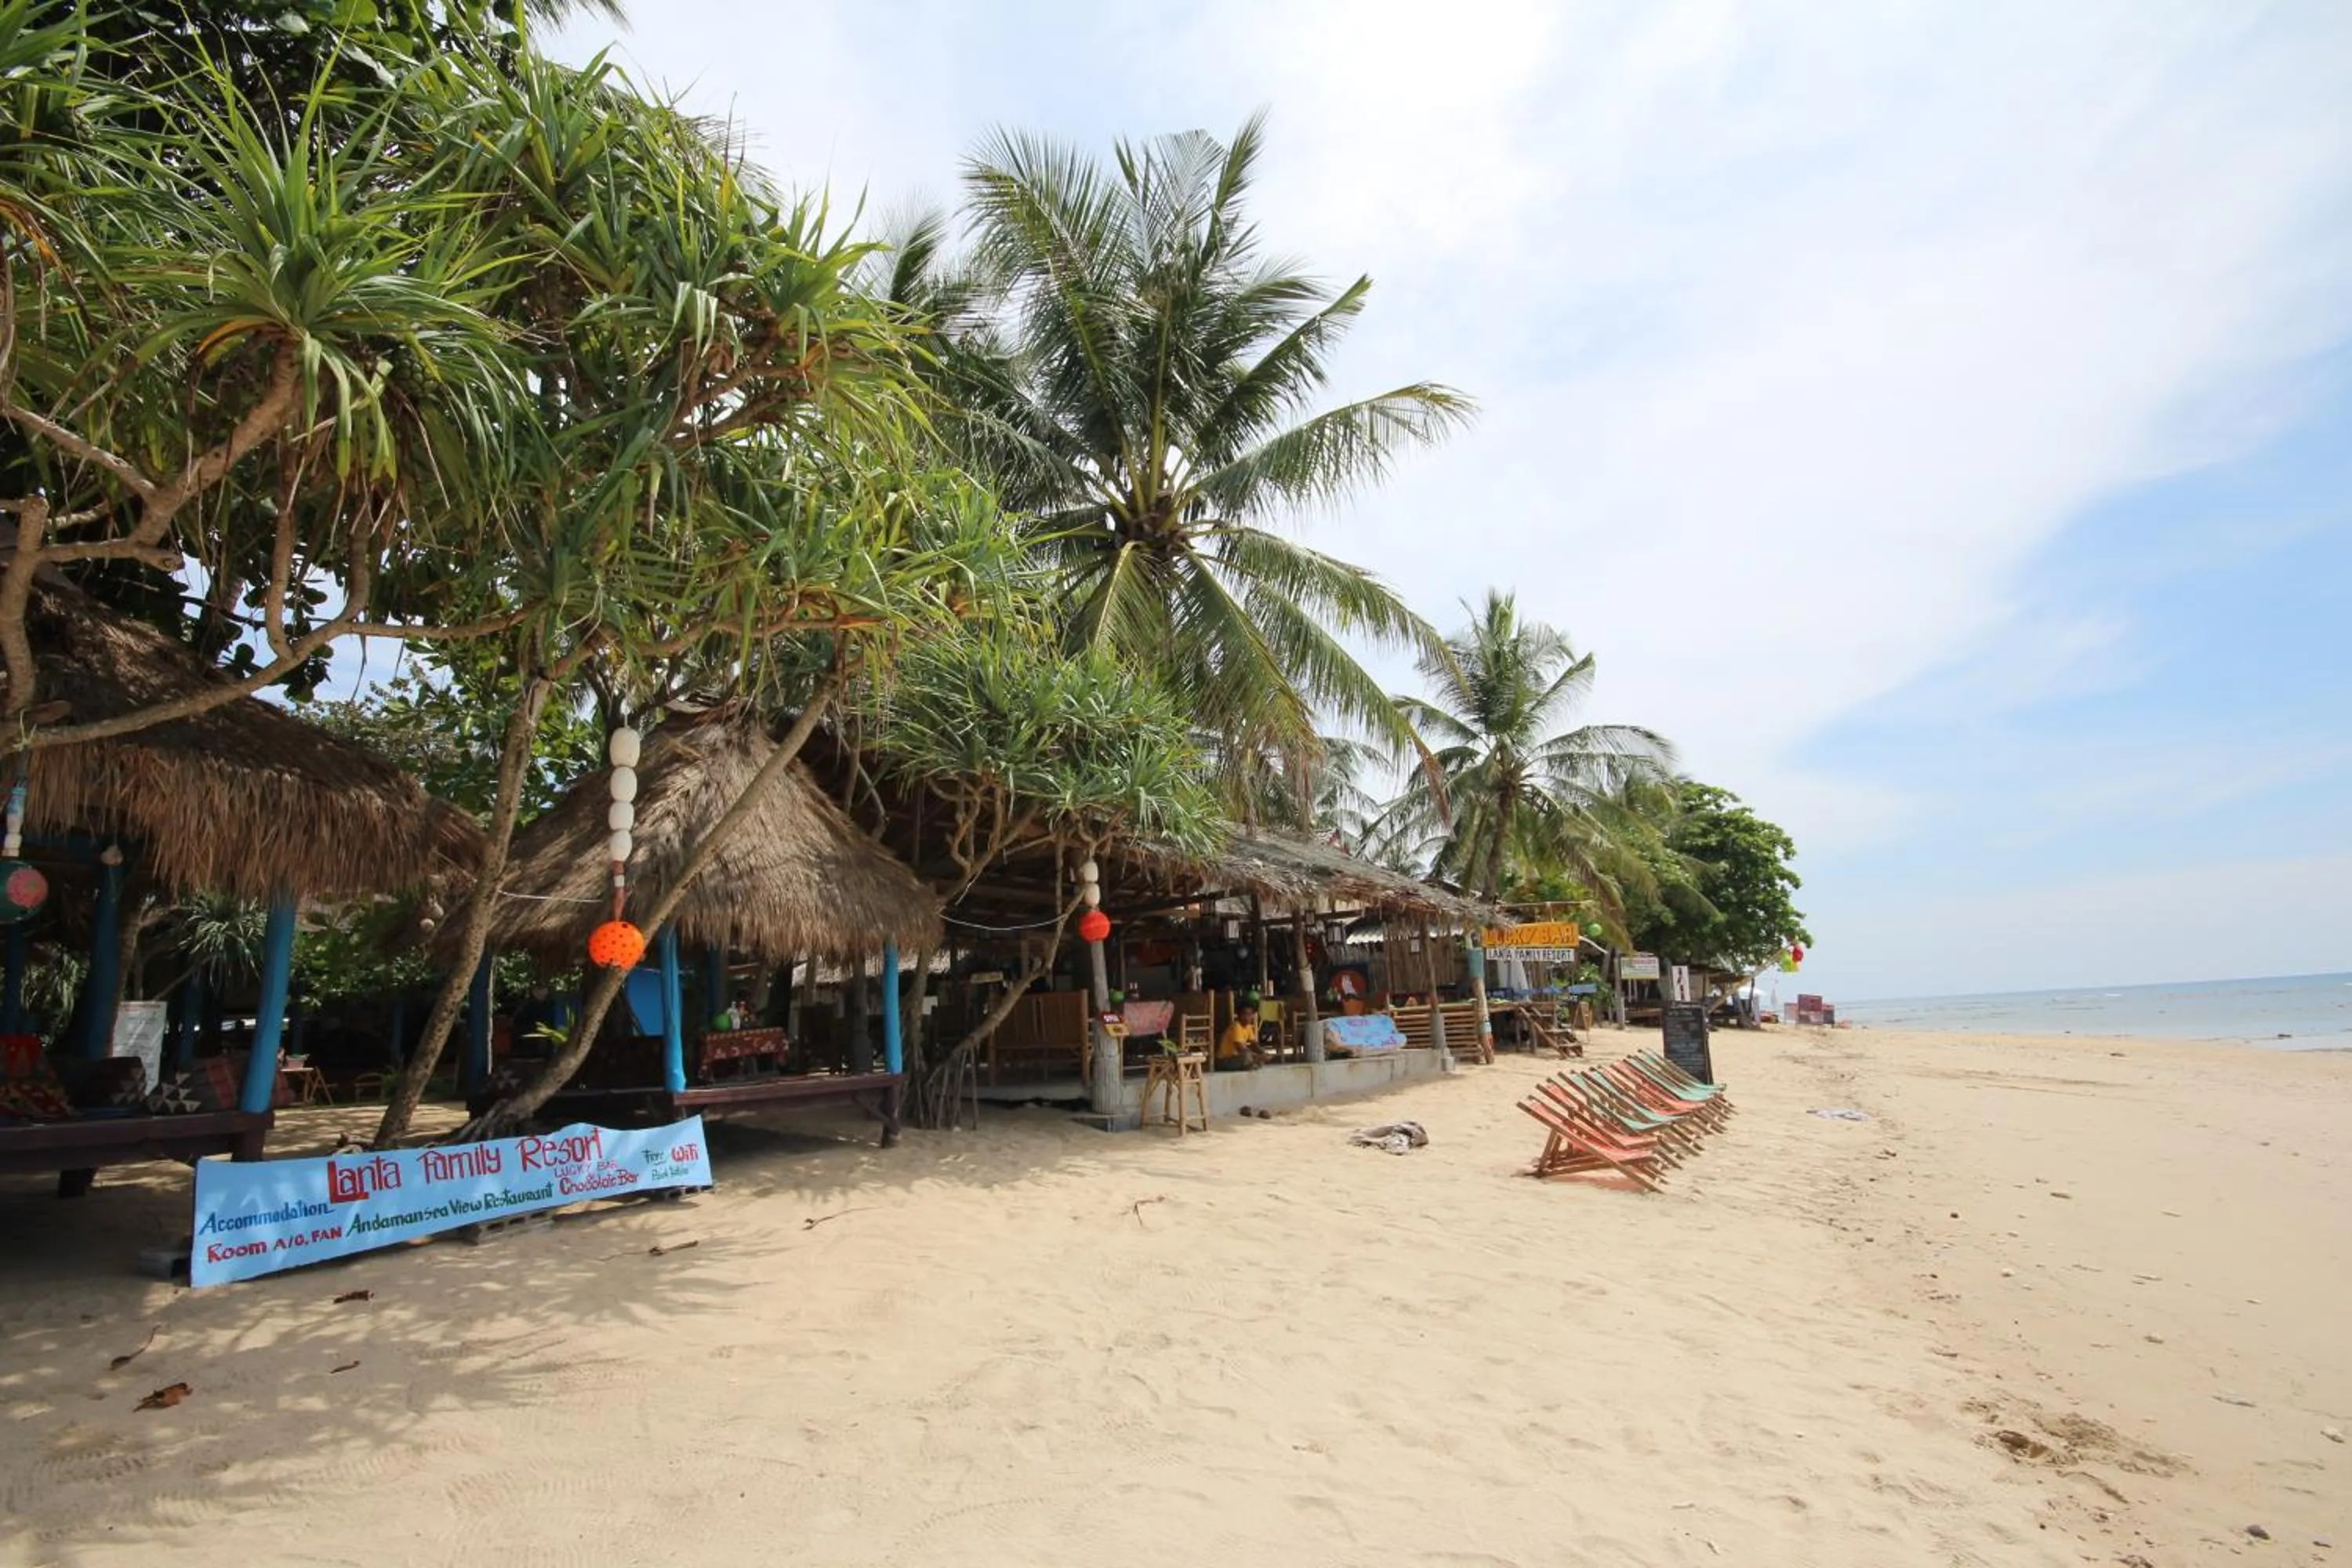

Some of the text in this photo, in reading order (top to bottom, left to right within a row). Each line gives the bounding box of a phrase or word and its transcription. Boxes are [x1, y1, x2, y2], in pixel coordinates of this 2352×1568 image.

[327, 1127, 602, 1204] Lanta Family Resort
[484, 1182, 554, 1210] Restaurant
[207, 1241, 267, 1263] Room
[311, 1226, 342, 1243] FAN
